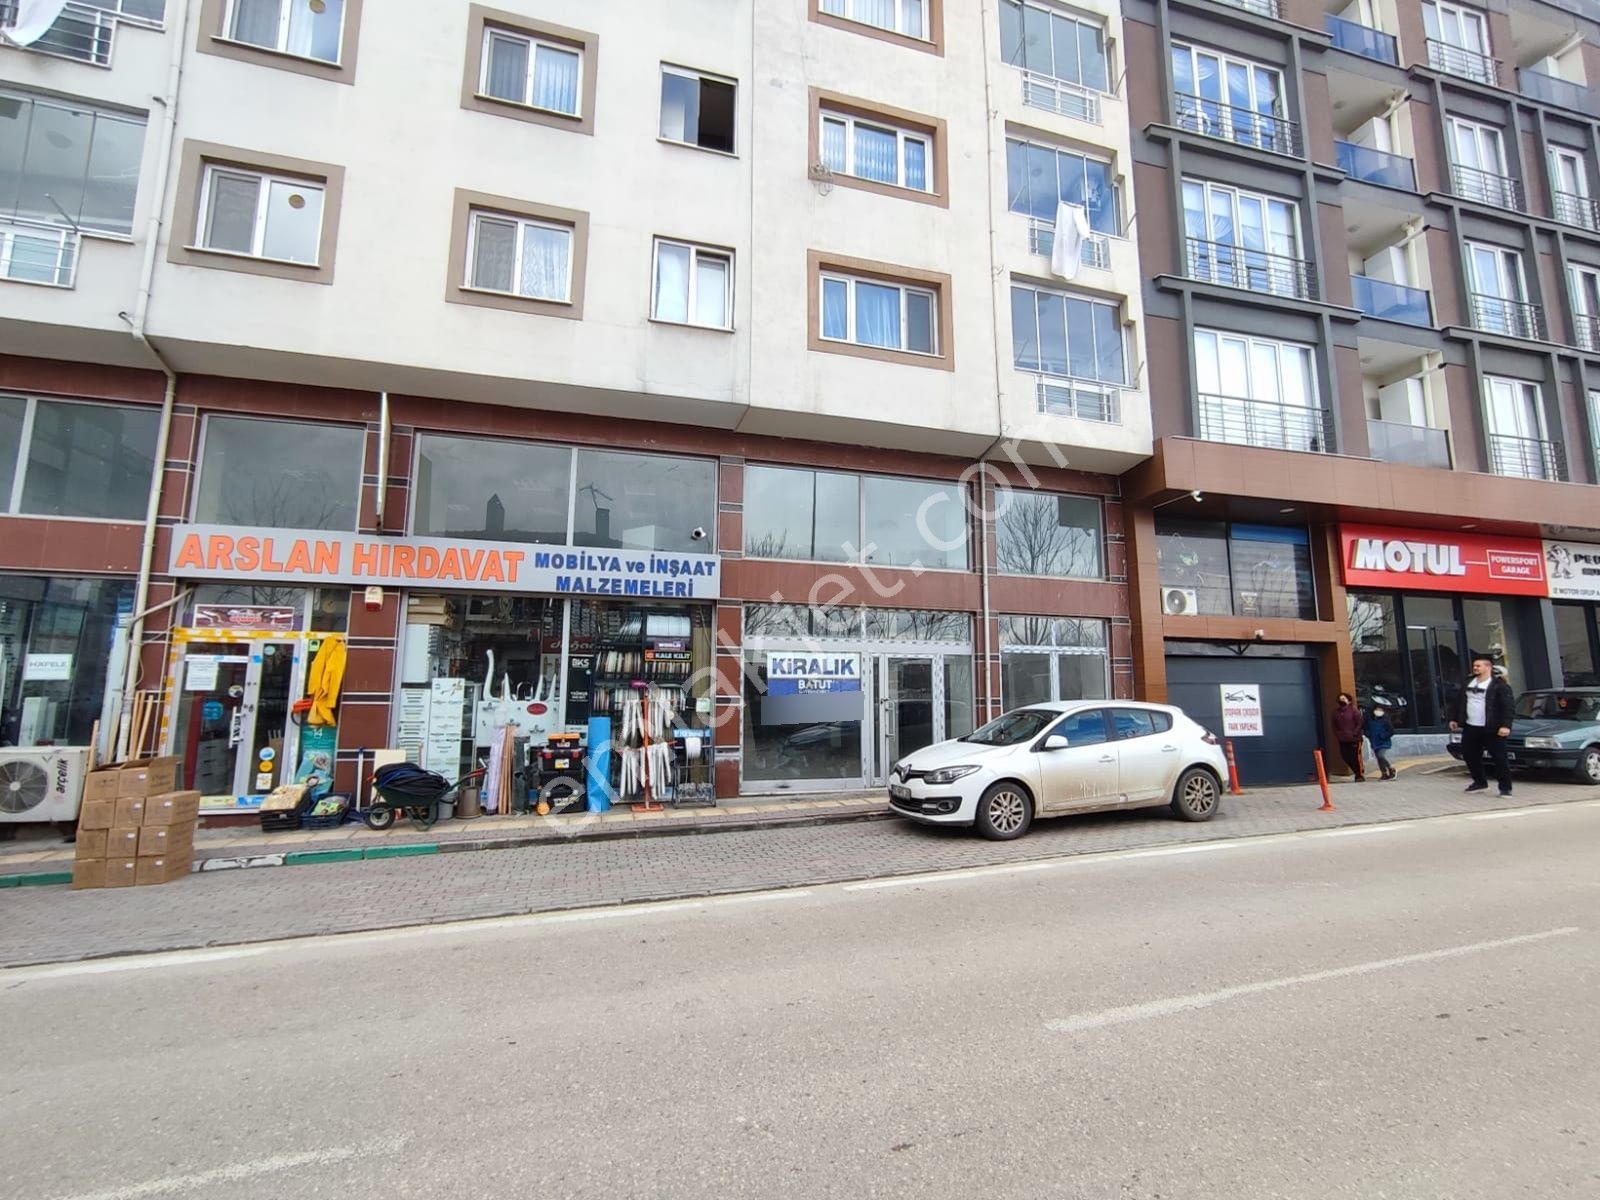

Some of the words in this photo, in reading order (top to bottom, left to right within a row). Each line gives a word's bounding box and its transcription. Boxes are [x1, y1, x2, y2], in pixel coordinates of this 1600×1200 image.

[174, 533, 342, 575] ARSLAN
[351, 542, 525, 582] HIRDAVAT
[534, 551, 621, 572] MOBİLYA
[626, 560, 645, 573] ve
[650, 554, 716, 577] İNŞAAT
[1347, 538, 1466, 576] MOTUL
[1491, 555, 1538, 566] POWERSPORT
[1501, 566, 1531, 575] GARAGE
[556, 576, 693, 597] MALZEMELERİ
[798, 680, 834, 690] BATUT
[55, 758, 70, 794] arçelik
